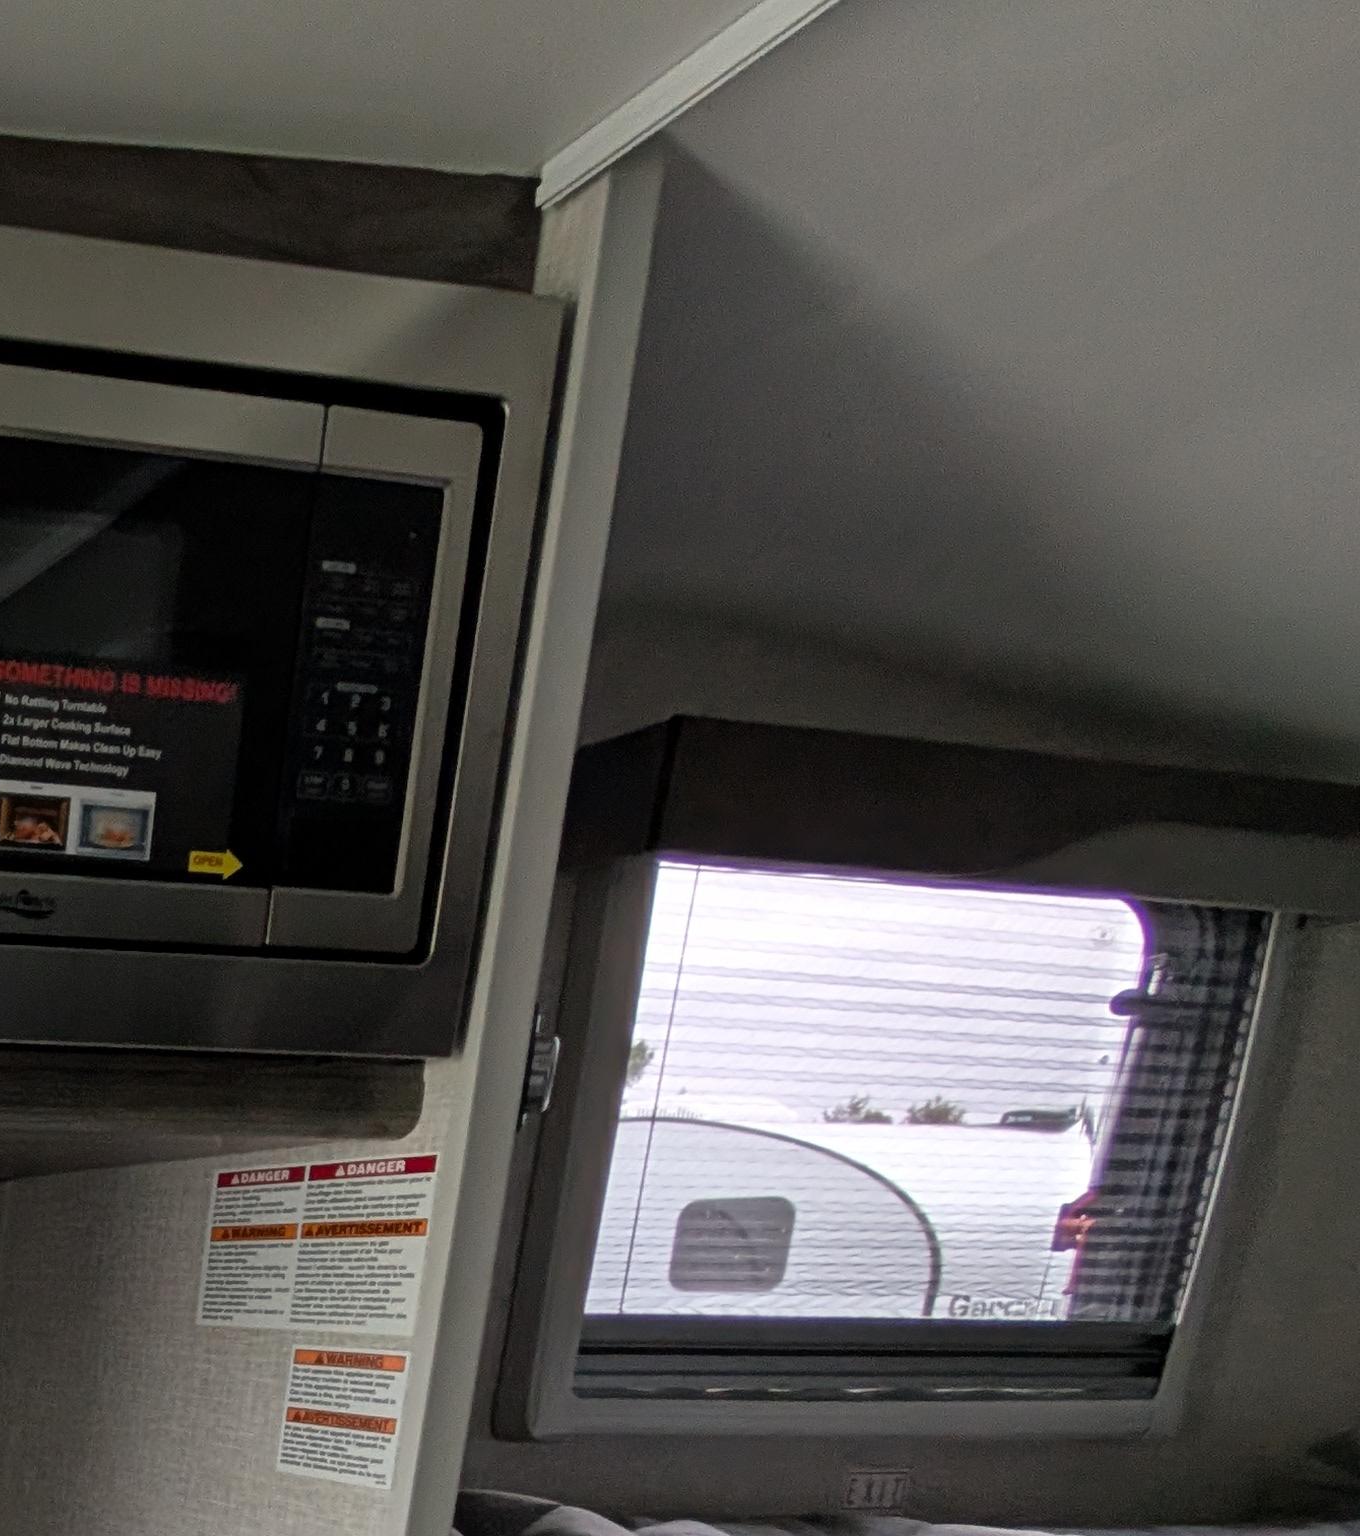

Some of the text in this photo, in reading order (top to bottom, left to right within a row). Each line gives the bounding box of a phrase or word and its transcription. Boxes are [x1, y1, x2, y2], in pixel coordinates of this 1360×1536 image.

[121, 671, 141, 694] IS
[4, 693, 19, 706] No
[2, 713, 131, 737] 2x Larger Cooking Surface
[1, 733, 162, 761] Flat Bottom Makes Clean Up Easy
[45, 758, 72, 771] Wave
[73, 759, 129, 777] Technology
[193, 854, 223, 867] OPEN
[346, 1160, 406, 1176] DANGER
[241, 1169, 290, 1184] DANGER
[231, 1224, 286, 1239] WARNING
[316, 1220, 423, 1236] AVERTISSEMENT
[323, 1352, 384, 1368] WARNING
